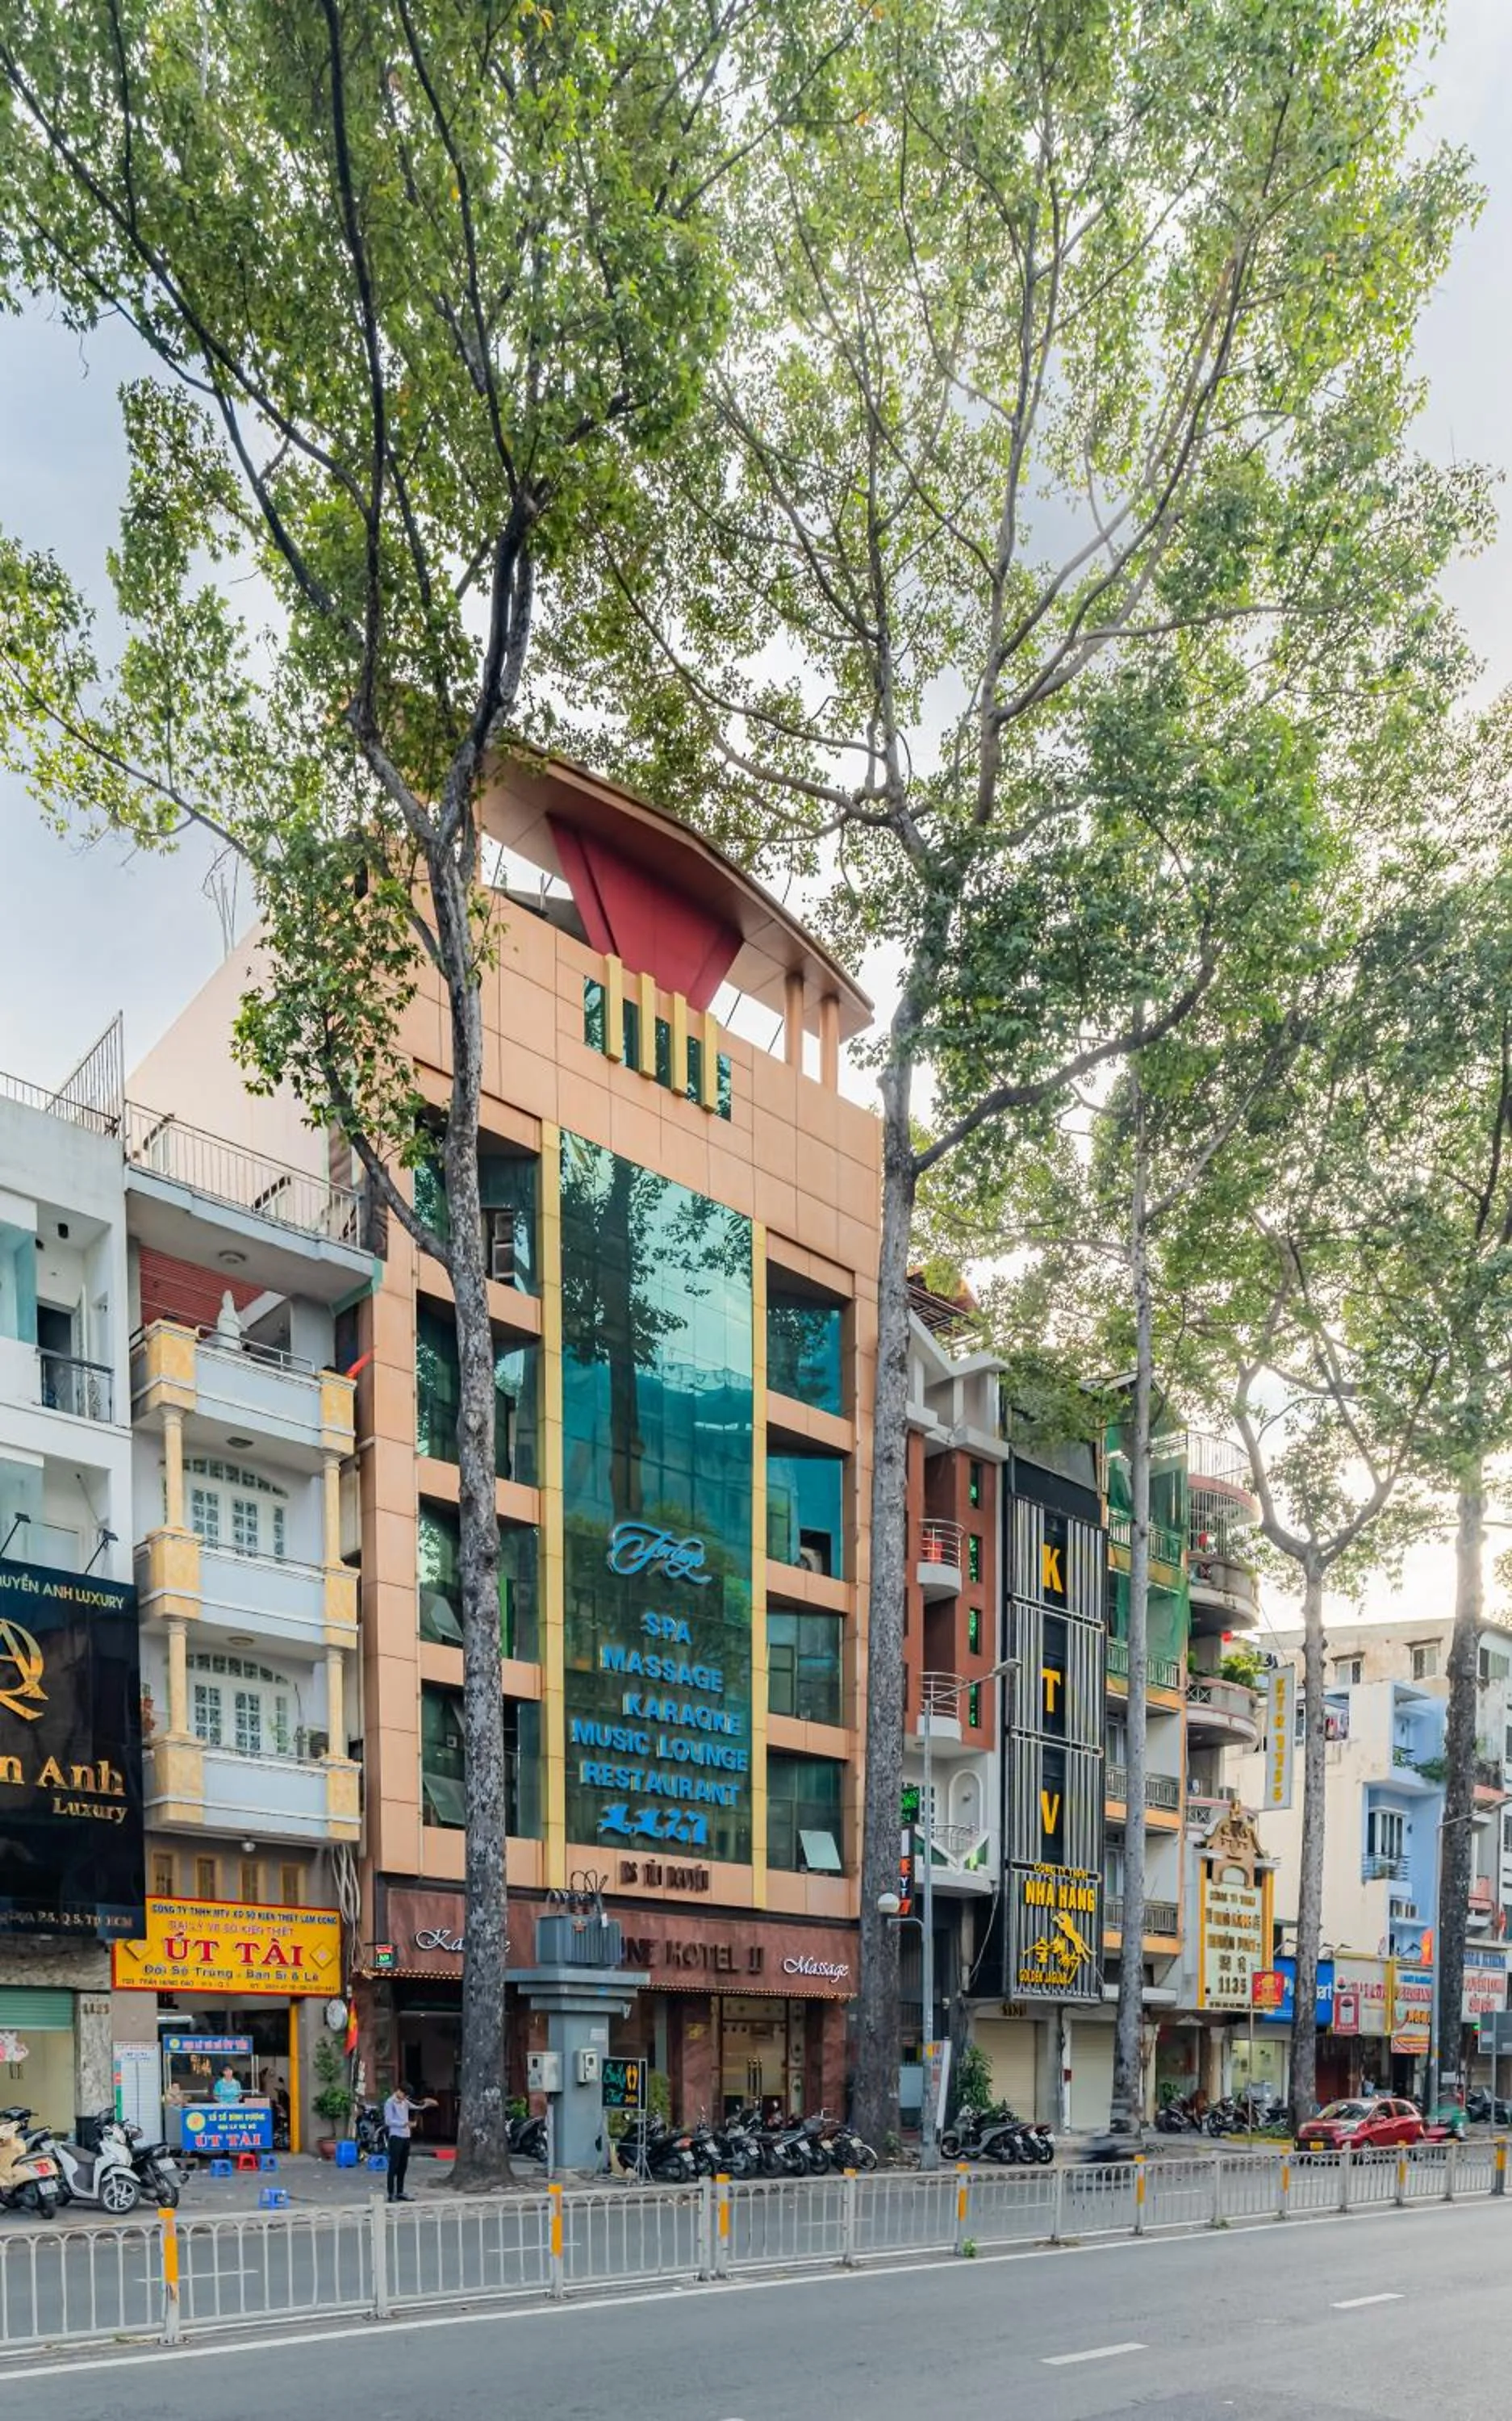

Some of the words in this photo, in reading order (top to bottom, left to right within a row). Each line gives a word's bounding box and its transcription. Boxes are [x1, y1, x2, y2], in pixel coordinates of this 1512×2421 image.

[43, 1583, 73, 1600] ANH
[75, 1590, 125, 1609] LUXURY
[641, 1612, 691, 1645] SPA
[599, 1644, 724, 1692] MASSAGE
[623, 1692, 741, 1735] KARAOKE
[570, 1718, 649, 1756] MUSIC
[656, 1733, 749, 1771] LOUNGE
[35, 1756, 126, 1796] Anh
[579, 1760, 740, 1806] RESTAURANT
[52, 1797, 127, 1824] Luxury
[597, 1804, 708, 1845] 1127
[1024, 1876, 1055, 1907] NHÀ
[1059, 1880, 1096, 1913] HÀNG
[165, 1932, 219, 1963] ÚT
[235, 1938, 304, 1967] TÀI
[666, 1939, 740, 1974] HOTEL
[783, 1955, 850, 1984] Massage
[194, 2131, 223, 2147] ÚT
[226, 2130, 261, 2147] TÀI
